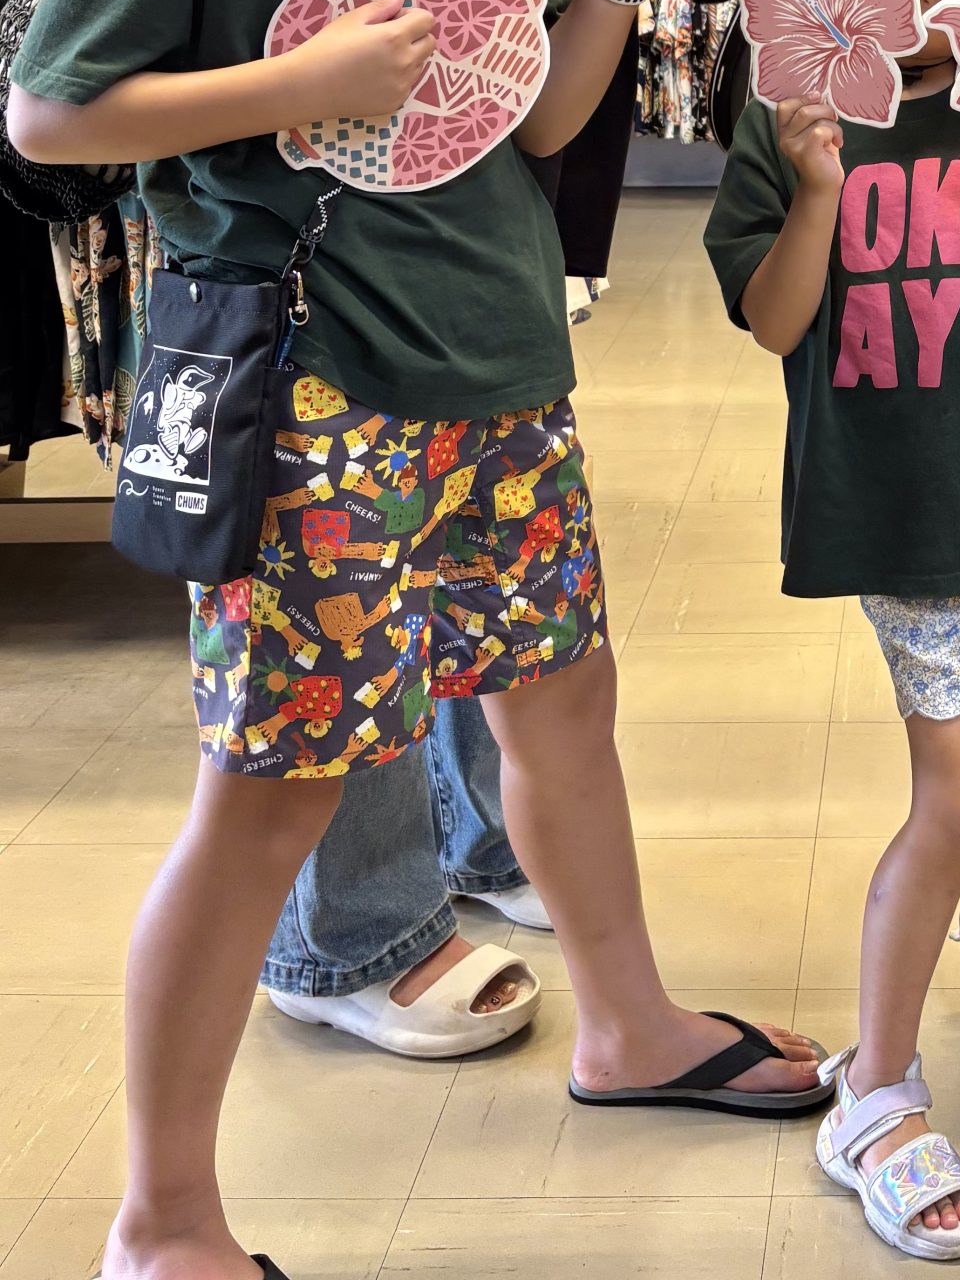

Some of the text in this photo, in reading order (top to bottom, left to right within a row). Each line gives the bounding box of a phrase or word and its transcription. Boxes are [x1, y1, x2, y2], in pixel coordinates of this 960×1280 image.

[274, 450, 302, 465] KANPA
[177, 494, 205, 511] CHUMS
[345, 500, 382, 524] CHEERS!
[286, 604, 321, 636] CHEERS!
[242, 753, 284, 773] CHEERS!
